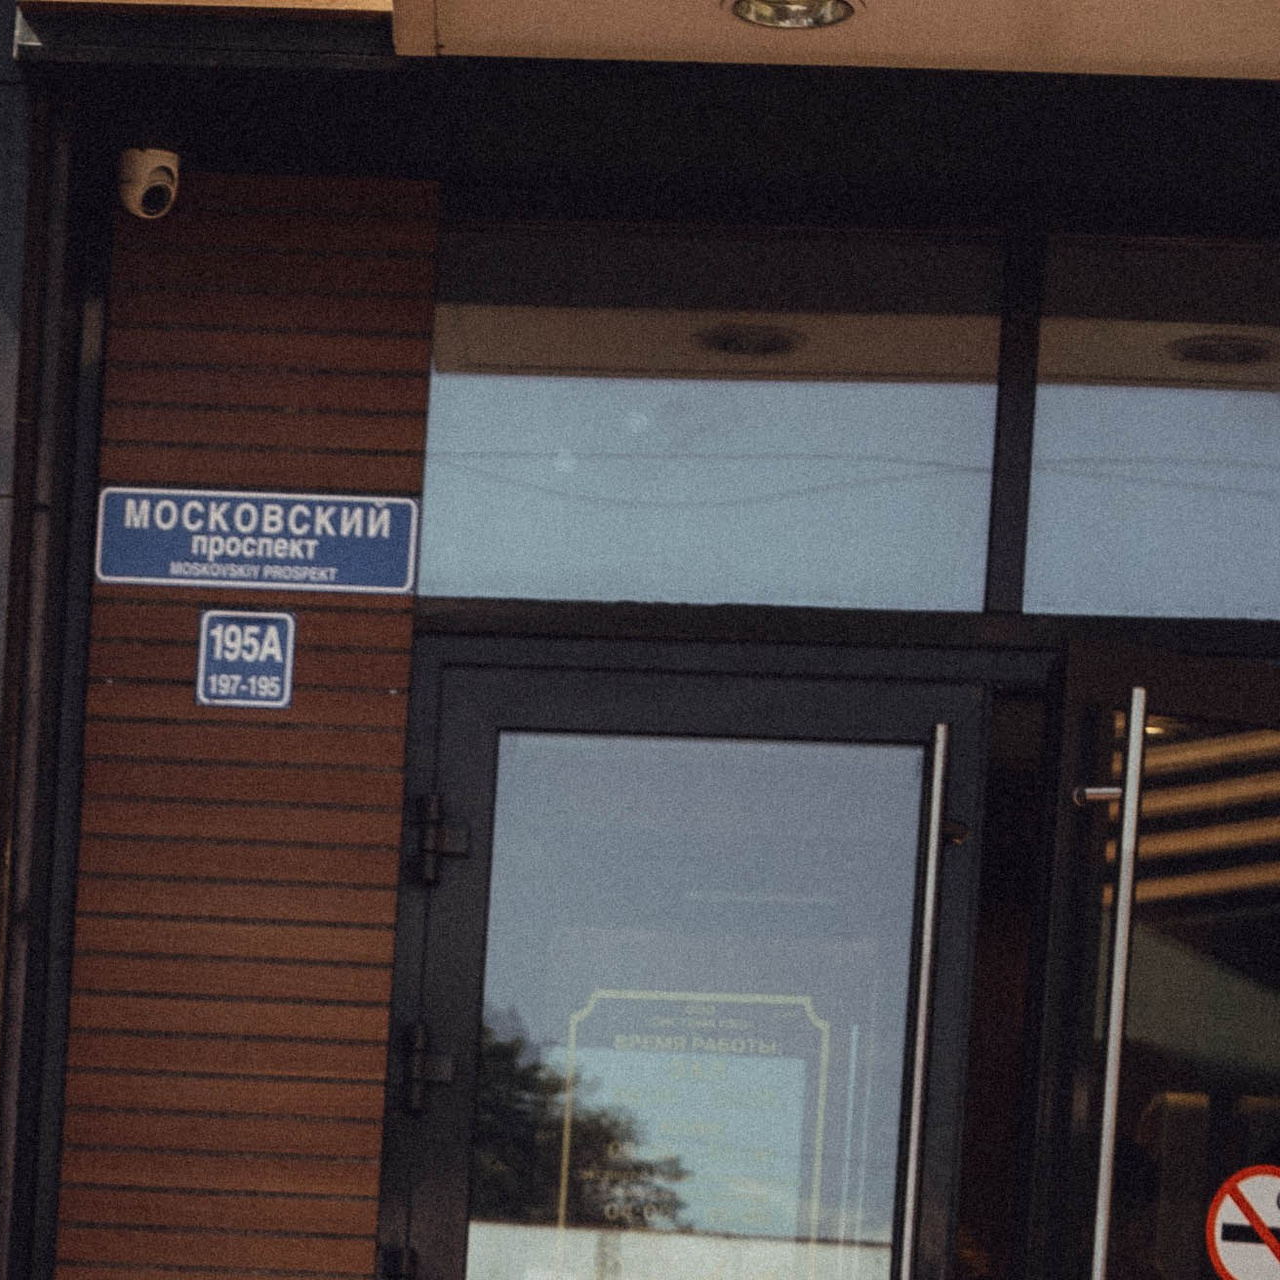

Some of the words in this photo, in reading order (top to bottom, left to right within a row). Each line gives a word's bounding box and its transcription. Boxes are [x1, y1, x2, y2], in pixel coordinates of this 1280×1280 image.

[123, 498, 391, 539] МОСКОВСКИЙ
[190, 533, 320, 561] проспект
[262, 564, 339, 582] PROSPEKT
[209, 674, 281, 698] 197-195
